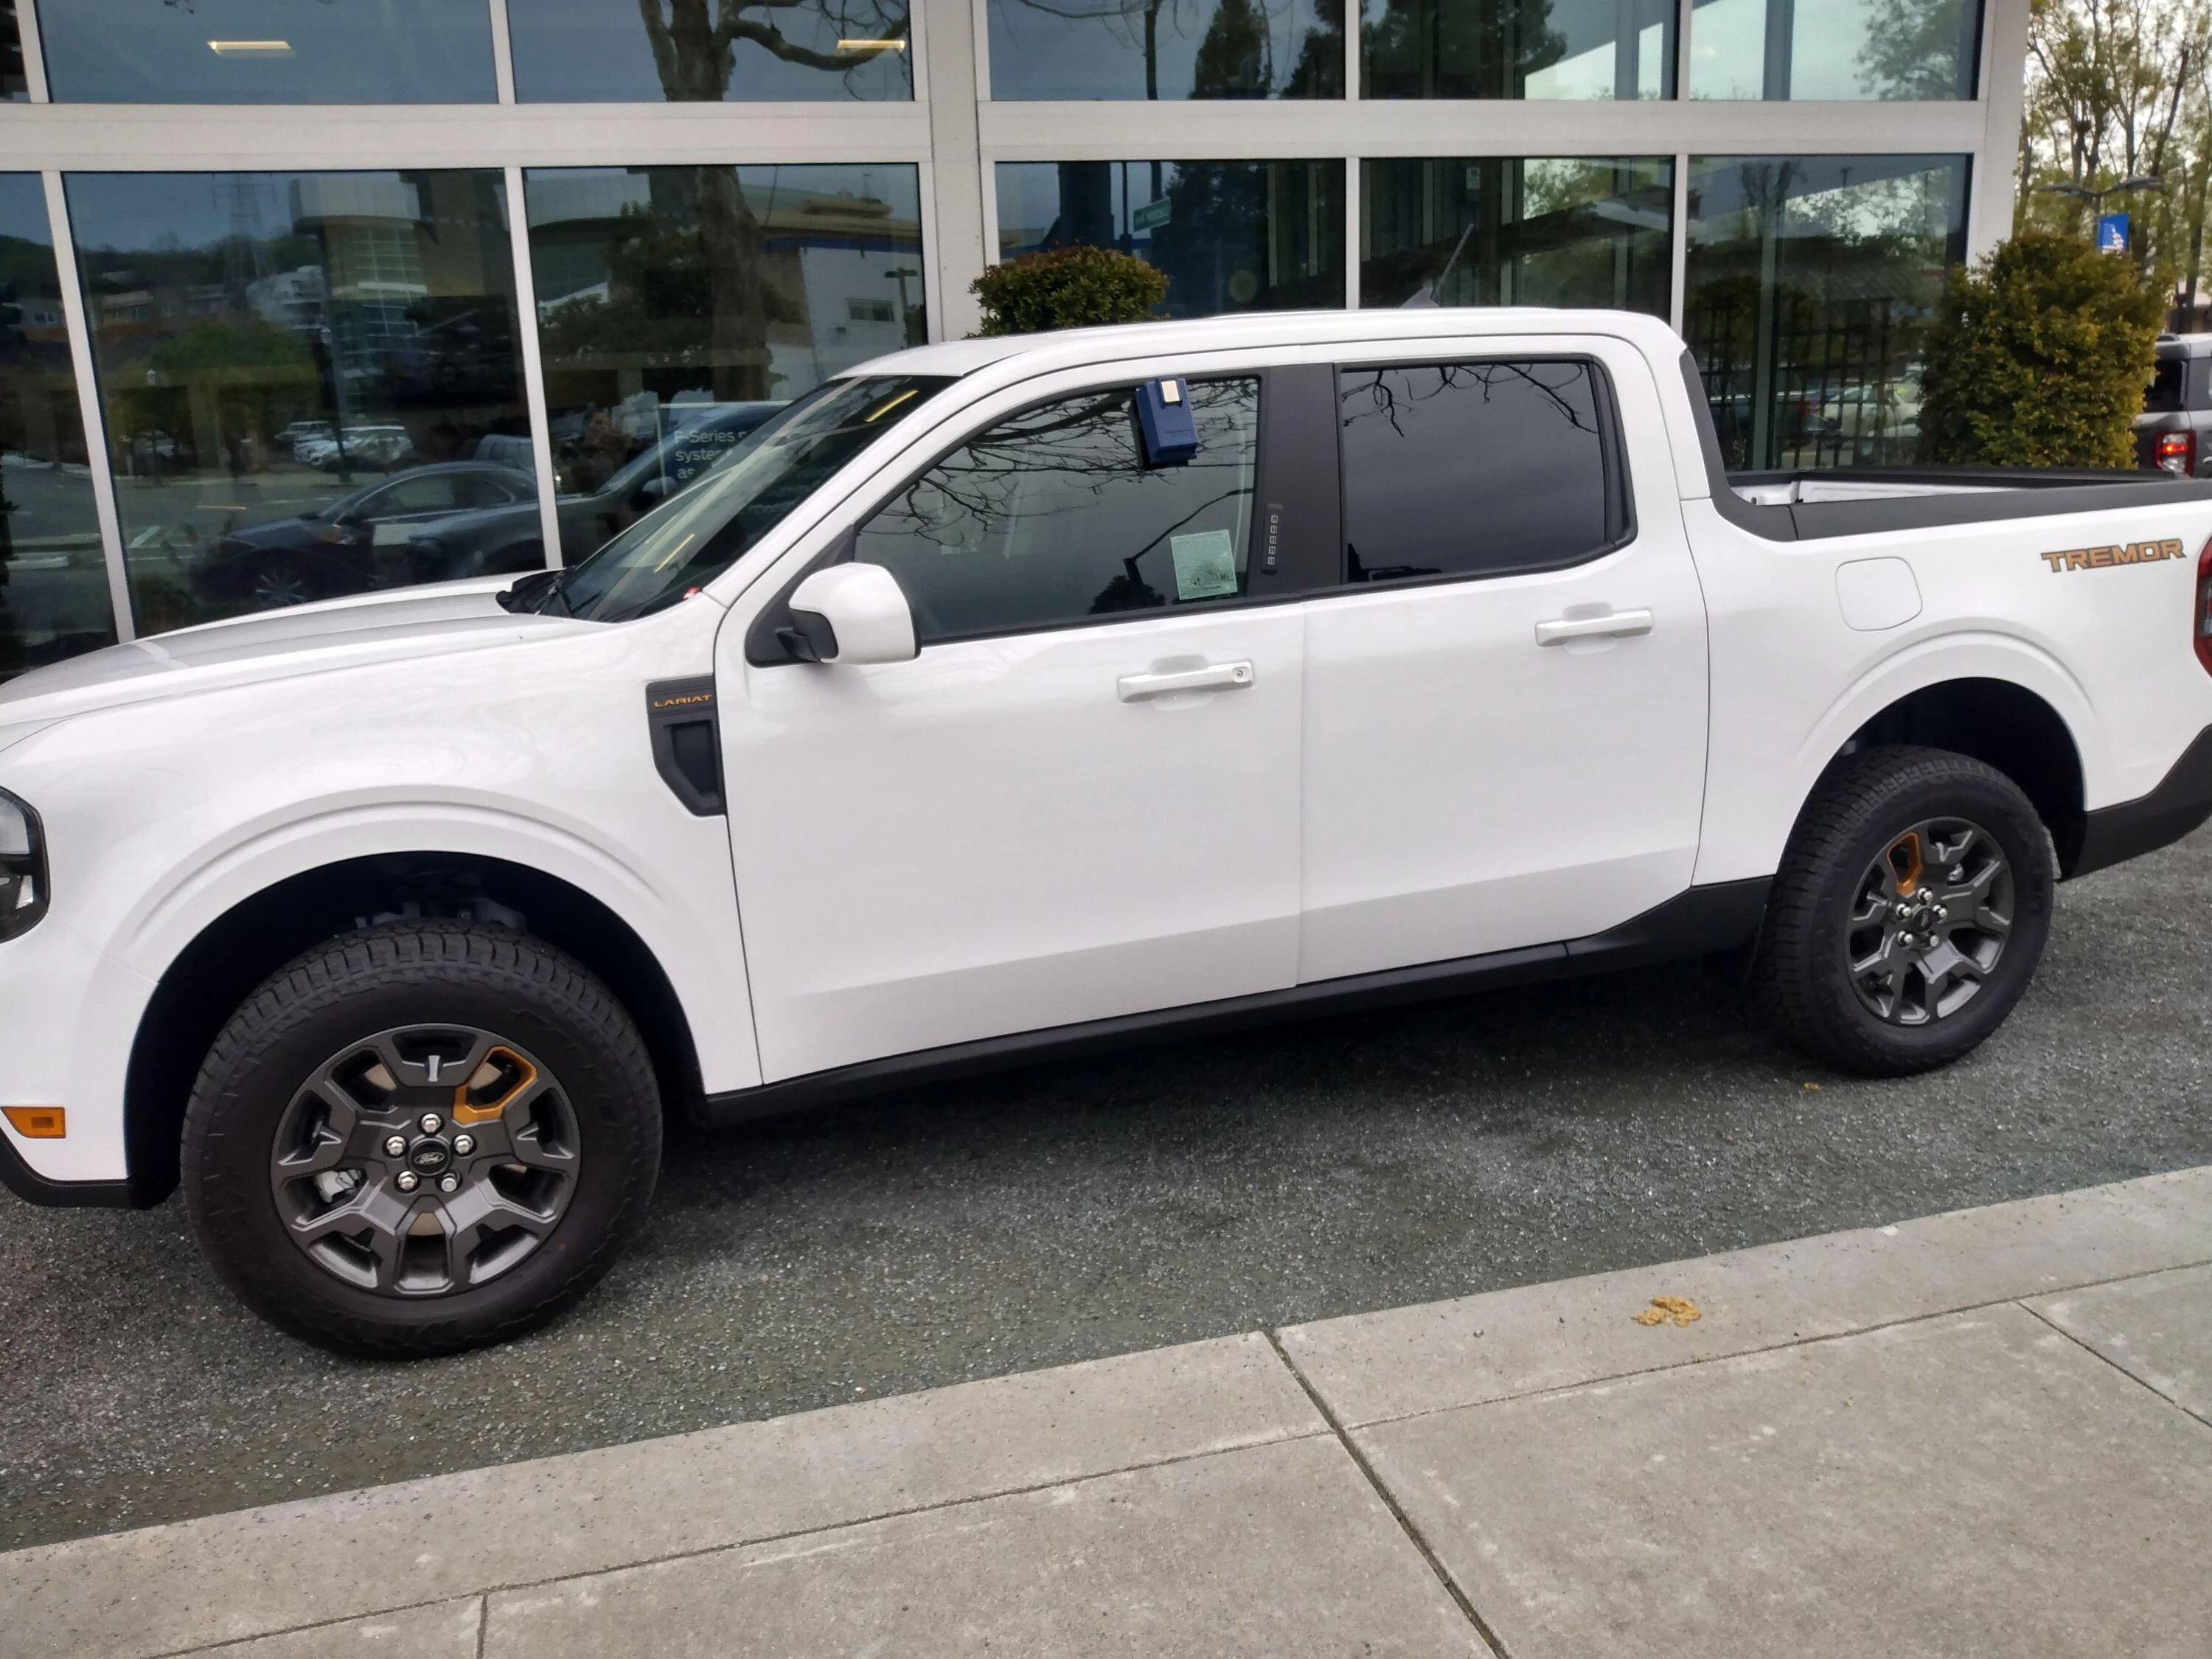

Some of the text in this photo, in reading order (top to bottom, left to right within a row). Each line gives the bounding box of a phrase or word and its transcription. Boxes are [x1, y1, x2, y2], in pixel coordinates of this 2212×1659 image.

[674, 430, 735, 443] F-Series
[2040, 538, 2187, 572] TREMOR
[654, 695, 712, 707] LARIAT
